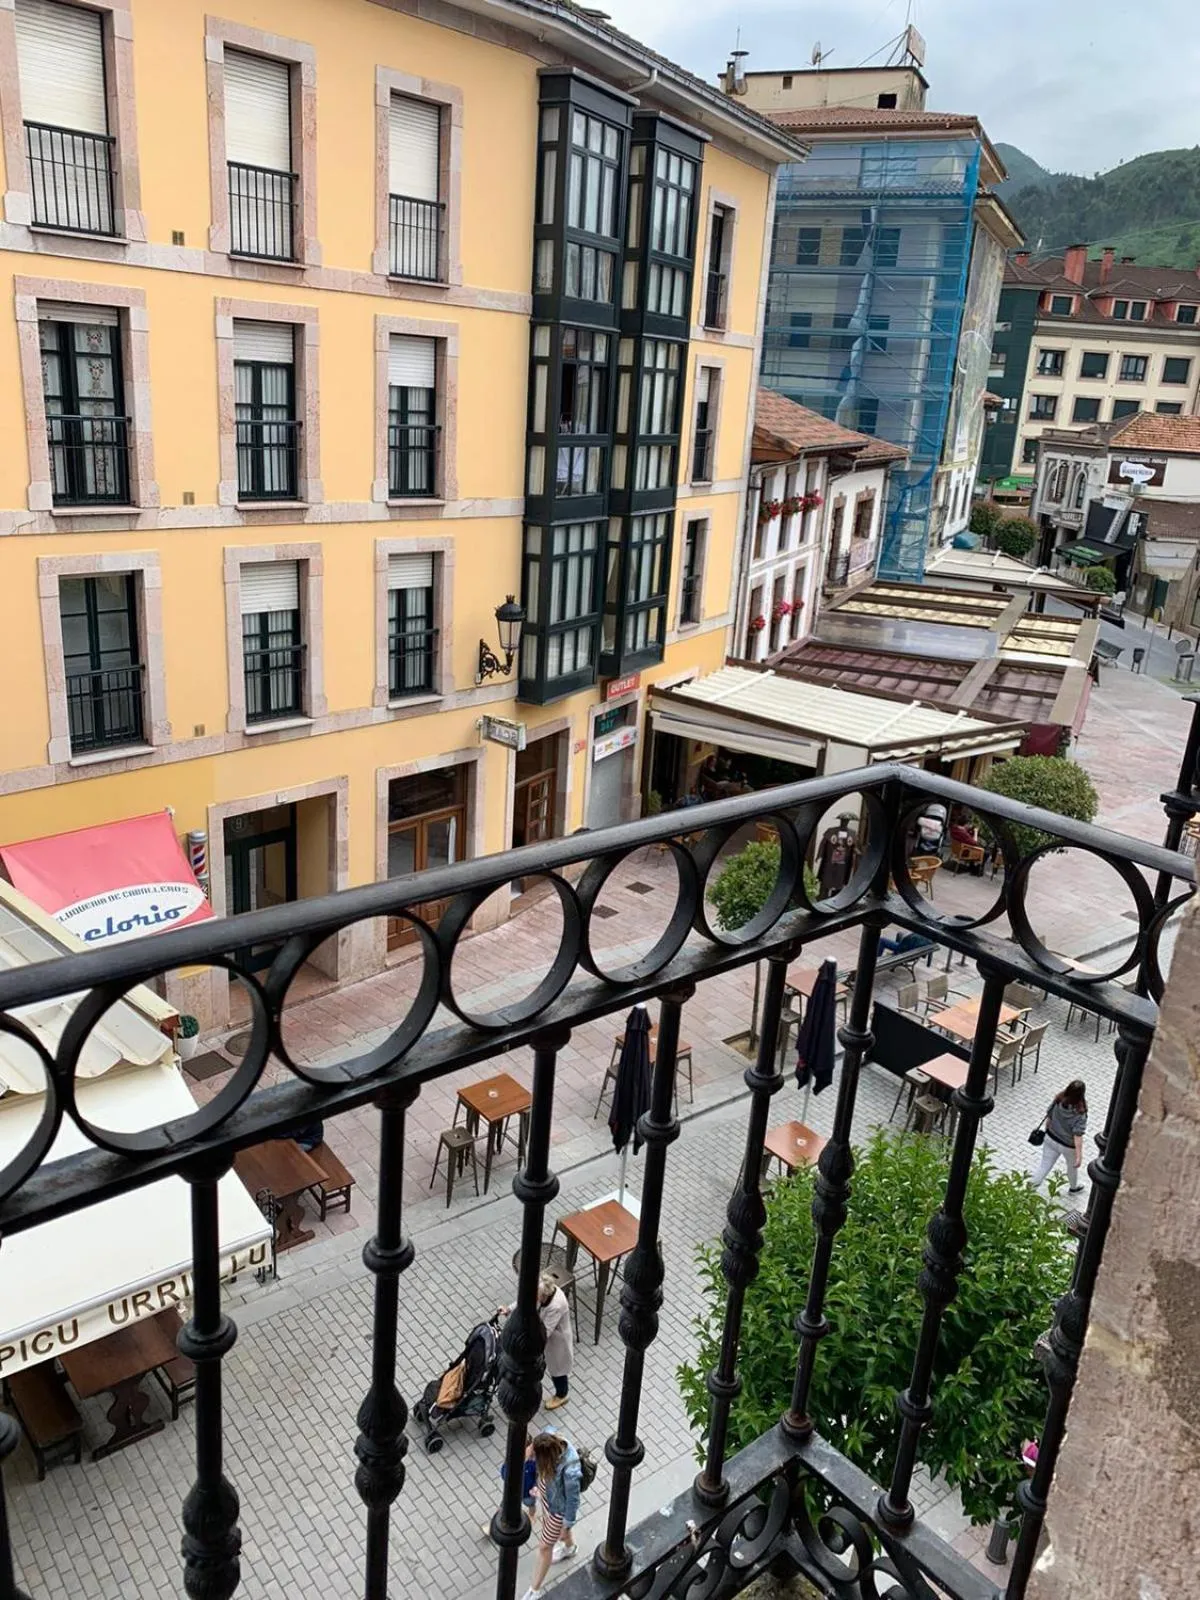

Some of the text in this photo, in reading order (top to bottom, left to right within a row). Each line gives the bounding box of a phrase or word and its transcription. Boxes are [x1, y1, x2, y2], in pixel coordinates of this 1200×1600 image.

[610, 676, 636, 693] OUTLET
[58, 898, 107, 922] LUQUERIA
[108, 893, 121, 902] DE
[0, 1319, 79, 1371] PICU
